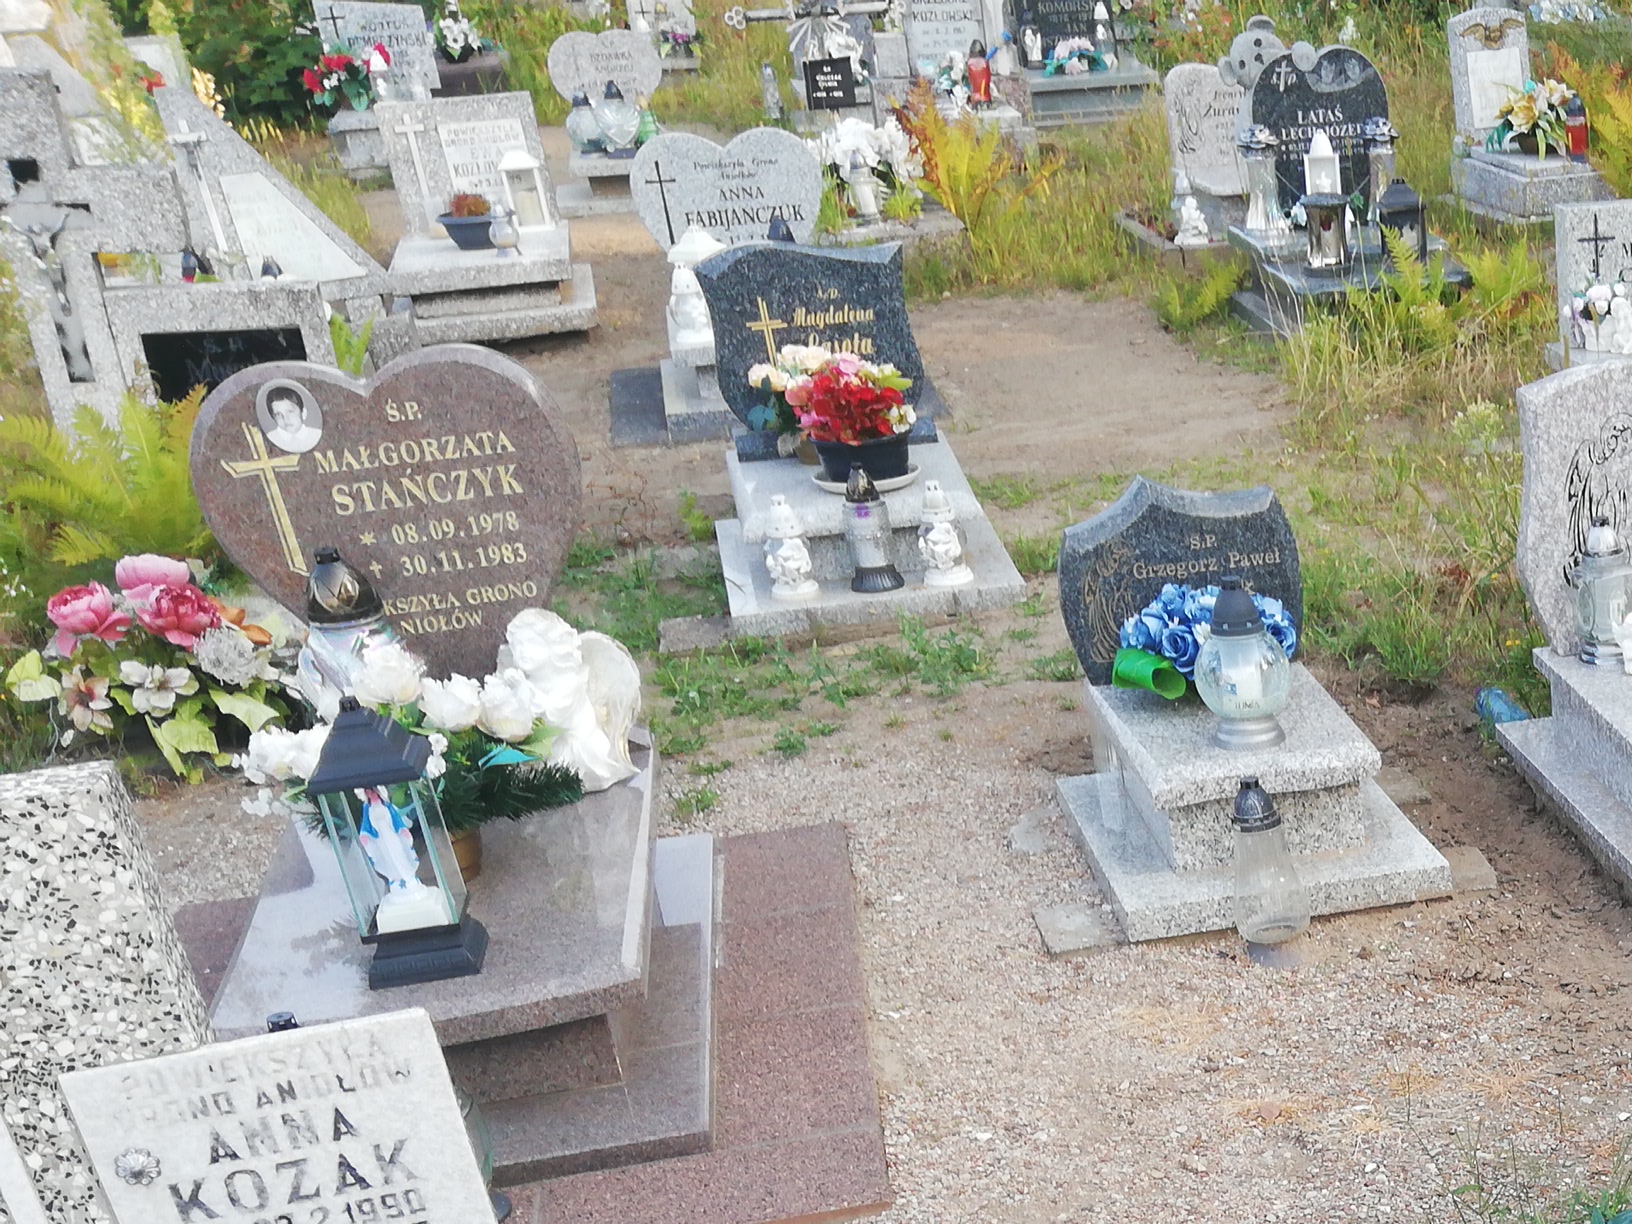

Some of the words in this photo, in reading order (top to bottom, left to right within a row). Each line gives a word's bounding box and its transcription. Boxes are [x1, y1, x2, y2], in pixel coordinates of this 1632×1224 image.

[1297, 103, 1343, 125] LATAŚ
[719, 186, 765, 201] ANNA
[793, 302, 876, 329] Magdalena
[387, 399, 422, 422] Ś.P.
[313, 430, 517, 475] MAŁGORZATA
[331, 463, 525, 516] STAŃCZYK
[391, 511, 521, 545] 08.09.1978
[400, 543, 529, 578] 30.11.1983
[1132, 560, 1218, 580] Grzegorz
[1228, 549, 1281, 569] Paweł
[383, 593, 461, 616] KSZYŁA
[466, 580, 539, 605] GRONO
[400, 609, 484, 636] NIOŁÓW
[209, 1105, 360, 1166] ANNA
[167, 1137, 420, 1224] KOZAK
